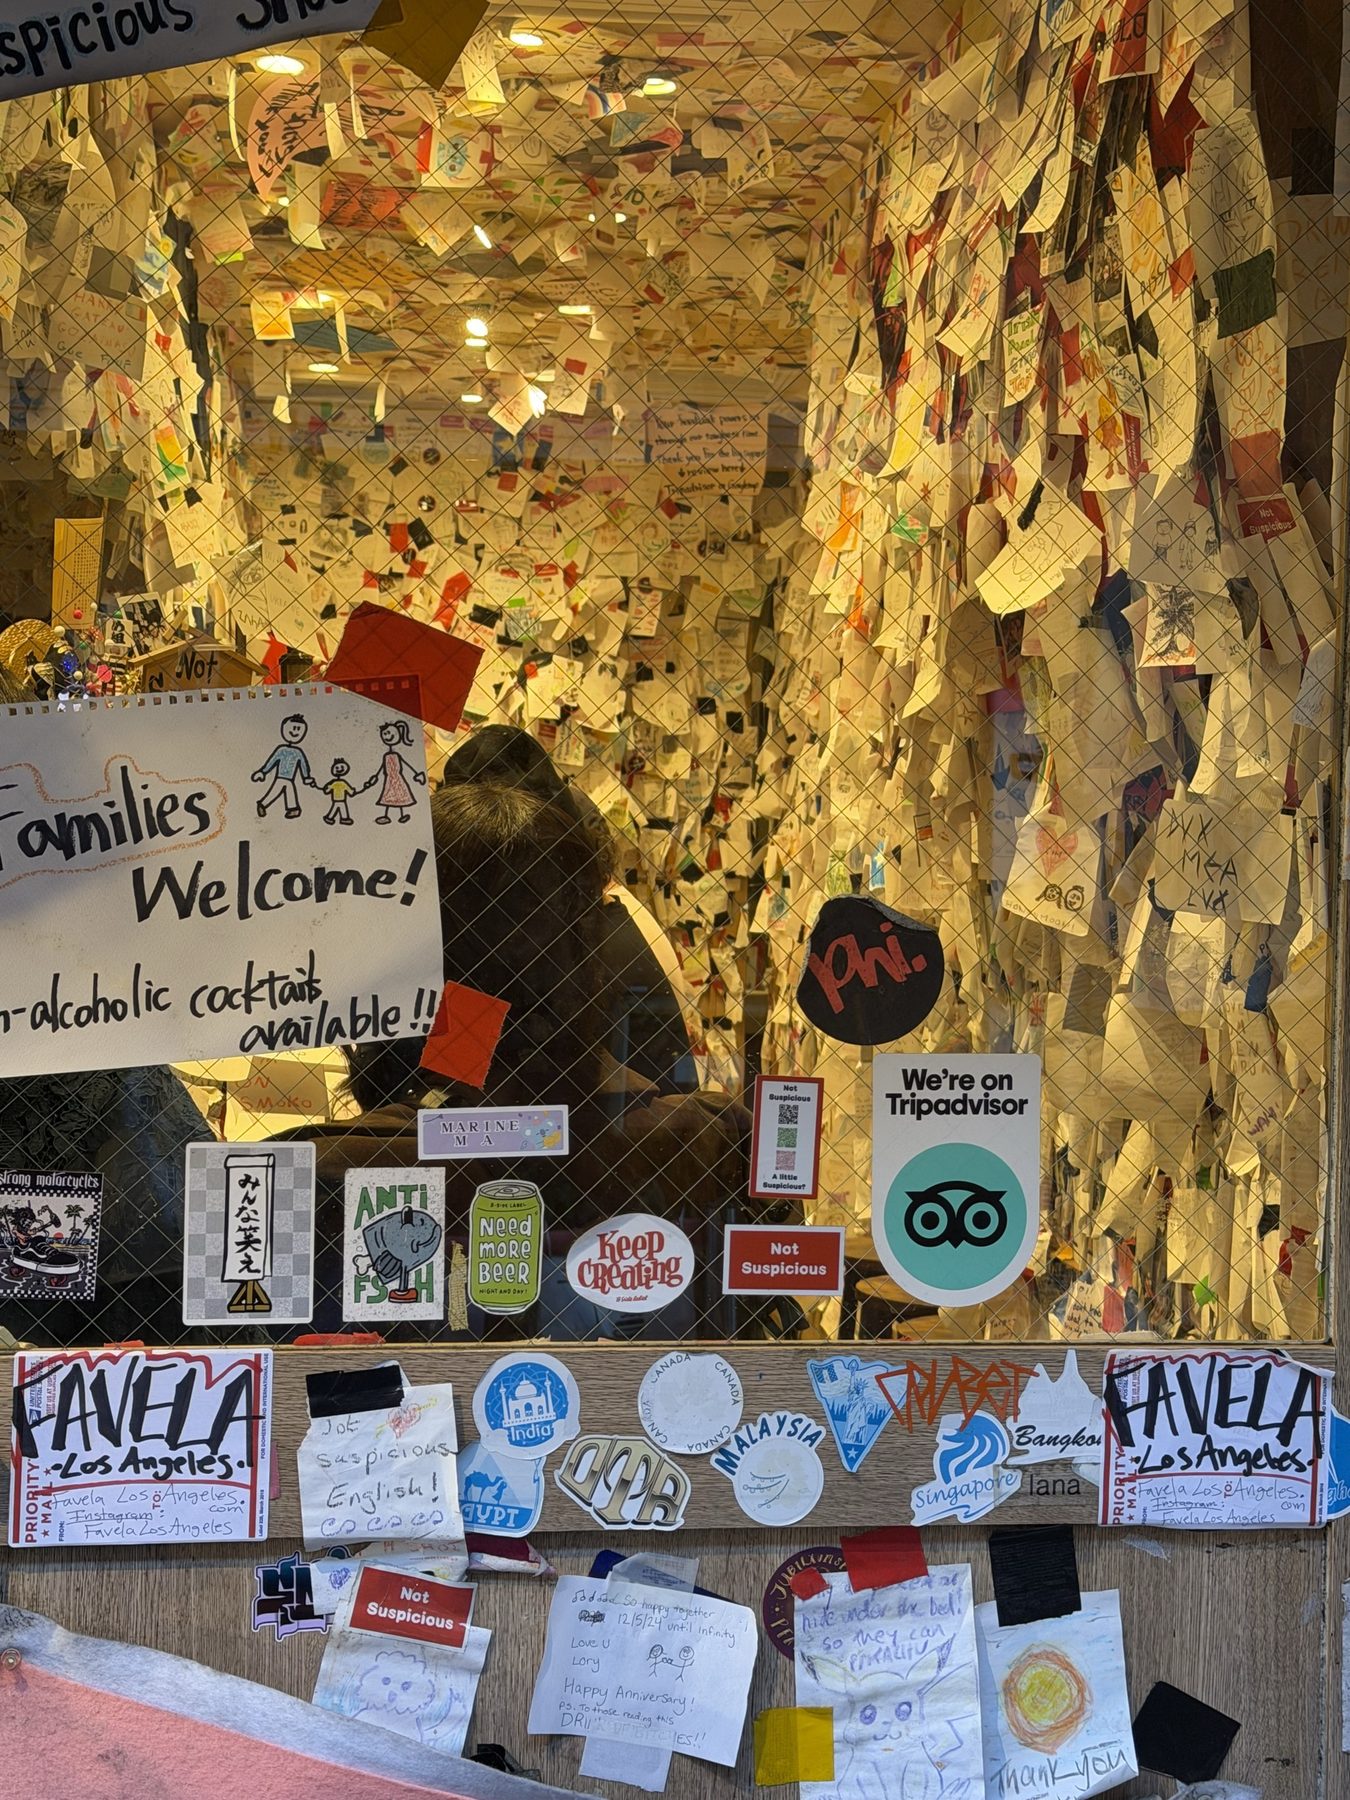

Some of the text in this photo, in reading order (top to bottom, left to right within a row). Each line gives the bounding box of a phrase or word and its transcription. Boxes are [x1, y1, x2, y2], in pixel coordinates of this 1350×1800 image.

[0, 0, 194, 78] spicious
[176, 650, 218, 684] Not
[132, 841, 428, 923] Welcome!
[902, 1067, 1013, 1091] We're on
[769, 1093, 811, 1102] Suspicious
[885, 1093, 1029, 1120] Tripadvisor
[441, 1120, 520, 1134] MARINE
[763, 1181, 806, 1190] Suspicious?
[235, 1174, 262, 1274] みんな笑え
[771, 1242, 800, 1256] Not
[742, 1261, 827, 1277] Suspicious
[651, 1353, 692, 1384] CANADA
[714, 1361, 741, 1406] CANADA
[11, 1355, 265, 1467] FAVELA
[1104, 1356, 1326, 1458] FAVELA
[511, 1424, 552, 1442] India
[687, 1425, 731, 1452] CANADA
[714, 1414, 823, 1476] MALAYSIA
[52, 1490, 105, 1510] Favela
[117, 1486, 149, 1504] Los
[915, 1470, 1019, 1508] Singapore
[1139, 1480, 1186, 1500] Favela
[1192, 1482, 1223, 1498] Los
[25, 1460, 39, 1543] PRIORITY
[462, 1503, 520, 1527] GYPT
[400, 1586, 430, 1604] Not
[366, 1602, 454, 1630] Suspicious
[642, 1599, 669, 1618] happy
[617, 1613, 662, 1631] 12/5/24
[667, 1621, 692, 1632] until
[909, 1624, 946, 1640] can
[571, 1638, 597, 1649] Love
[572, 1656, 600, 1673] Lory
[564, 1677, 609, 1705] Happy
[592, 1705, 619, 1717] those
[623, 1711, 652, 1728] reading
[656, 1713, 674, 1726] this
